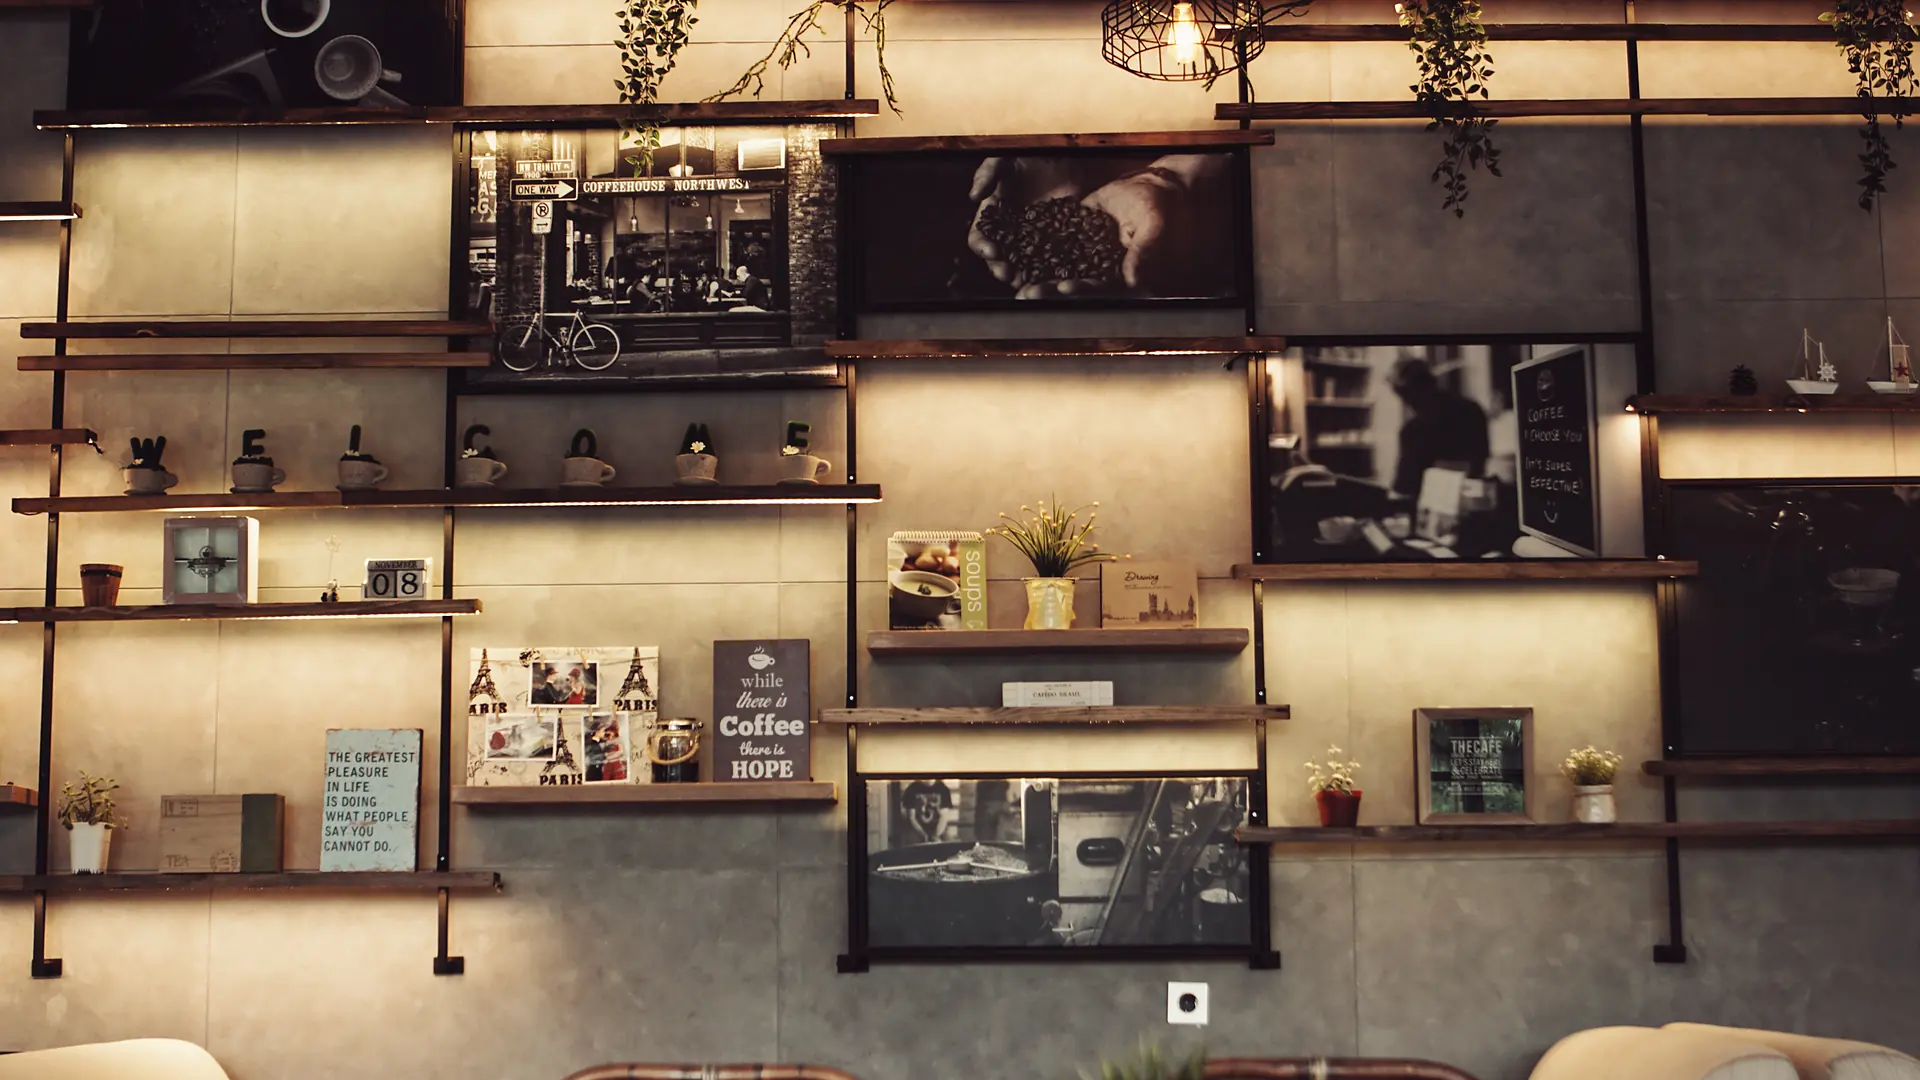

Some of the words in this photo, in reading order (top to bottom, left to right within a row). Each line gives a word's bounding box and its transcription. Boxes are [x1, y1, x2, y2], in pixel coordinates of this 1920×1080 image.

[517, 185, 536, 194] ONE
[539, 185, 557, 194] WAY
[583, 180, 666, 193] COFFEEHOUSE
[1530, 429, 1560, 442] CHOOSE
[1563, 430, 1583, 442] YOU
[1124, 570, 1159, 585] Drawing
[740, 672, 784, 688] while
[735, 691, 773, 708] there
[775, 692, 787, 708] is
[719, 713, 804, 737] Coffee
[739, 741, 772, 755] there
[773, 743, 785, 755] is
[328, 752, 351, 763] THE
[354, 751, 415, 763] GREATEST
[327, 766, 389, 778] PLEASURE
[731, 760, 794, 779] HOPE
[327, 781, 339, 792] IN
[343, 781, 370, 792] LIFE
[326, 796, 338, 807] IS
[341, 796, 377, 807] DOING
[325, 811, 359, 822] WHAT
[363, 811, 409, 822] PEOPLE
[325, 826, 347, 837] SAY
[351, 826, 374, 837] YOU
[323, 840, 370, 852] CANNOT
[374, 840, 392, 852] DO.
[165, 854, 189, 868] TEA
